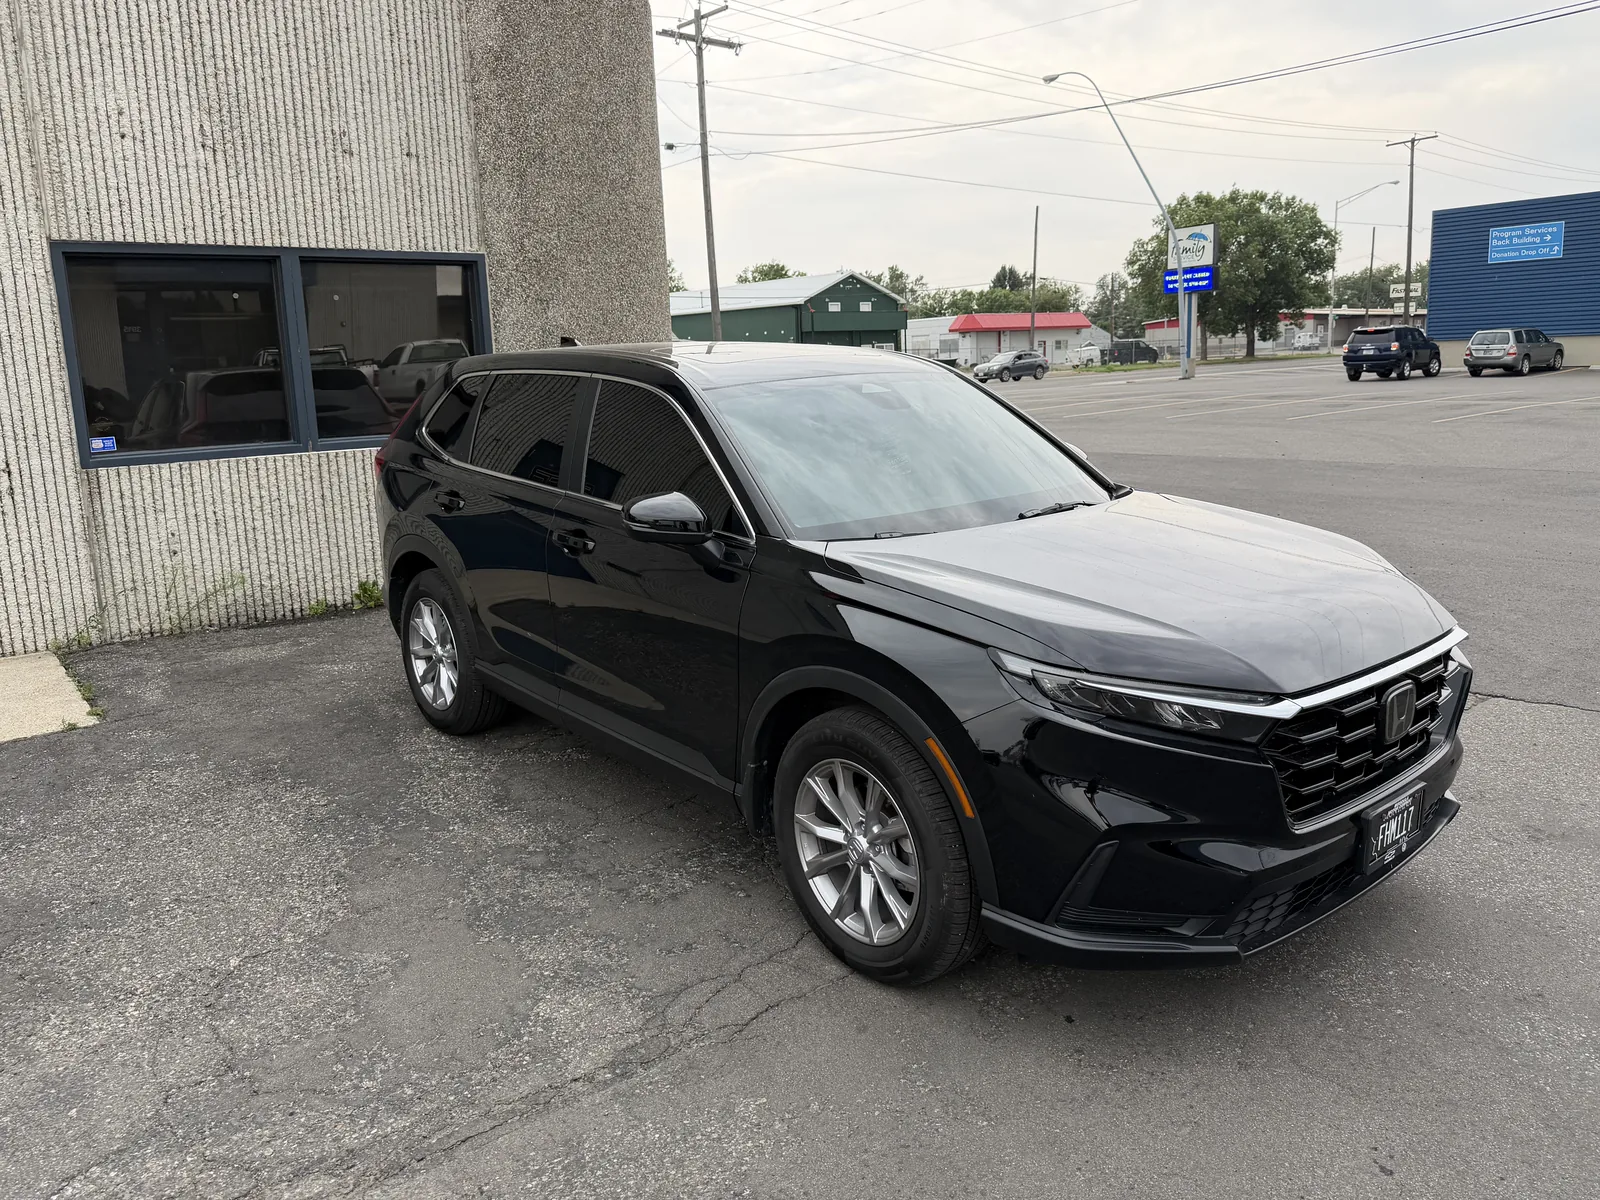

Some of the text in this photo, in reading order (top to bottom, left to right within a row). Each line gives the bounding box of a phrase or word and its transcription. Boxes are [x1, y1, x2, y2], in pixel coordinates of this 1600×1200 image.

[1492, 226, 1558, 238] Program Services
[1492, 236, 1541, 246] Back Building
